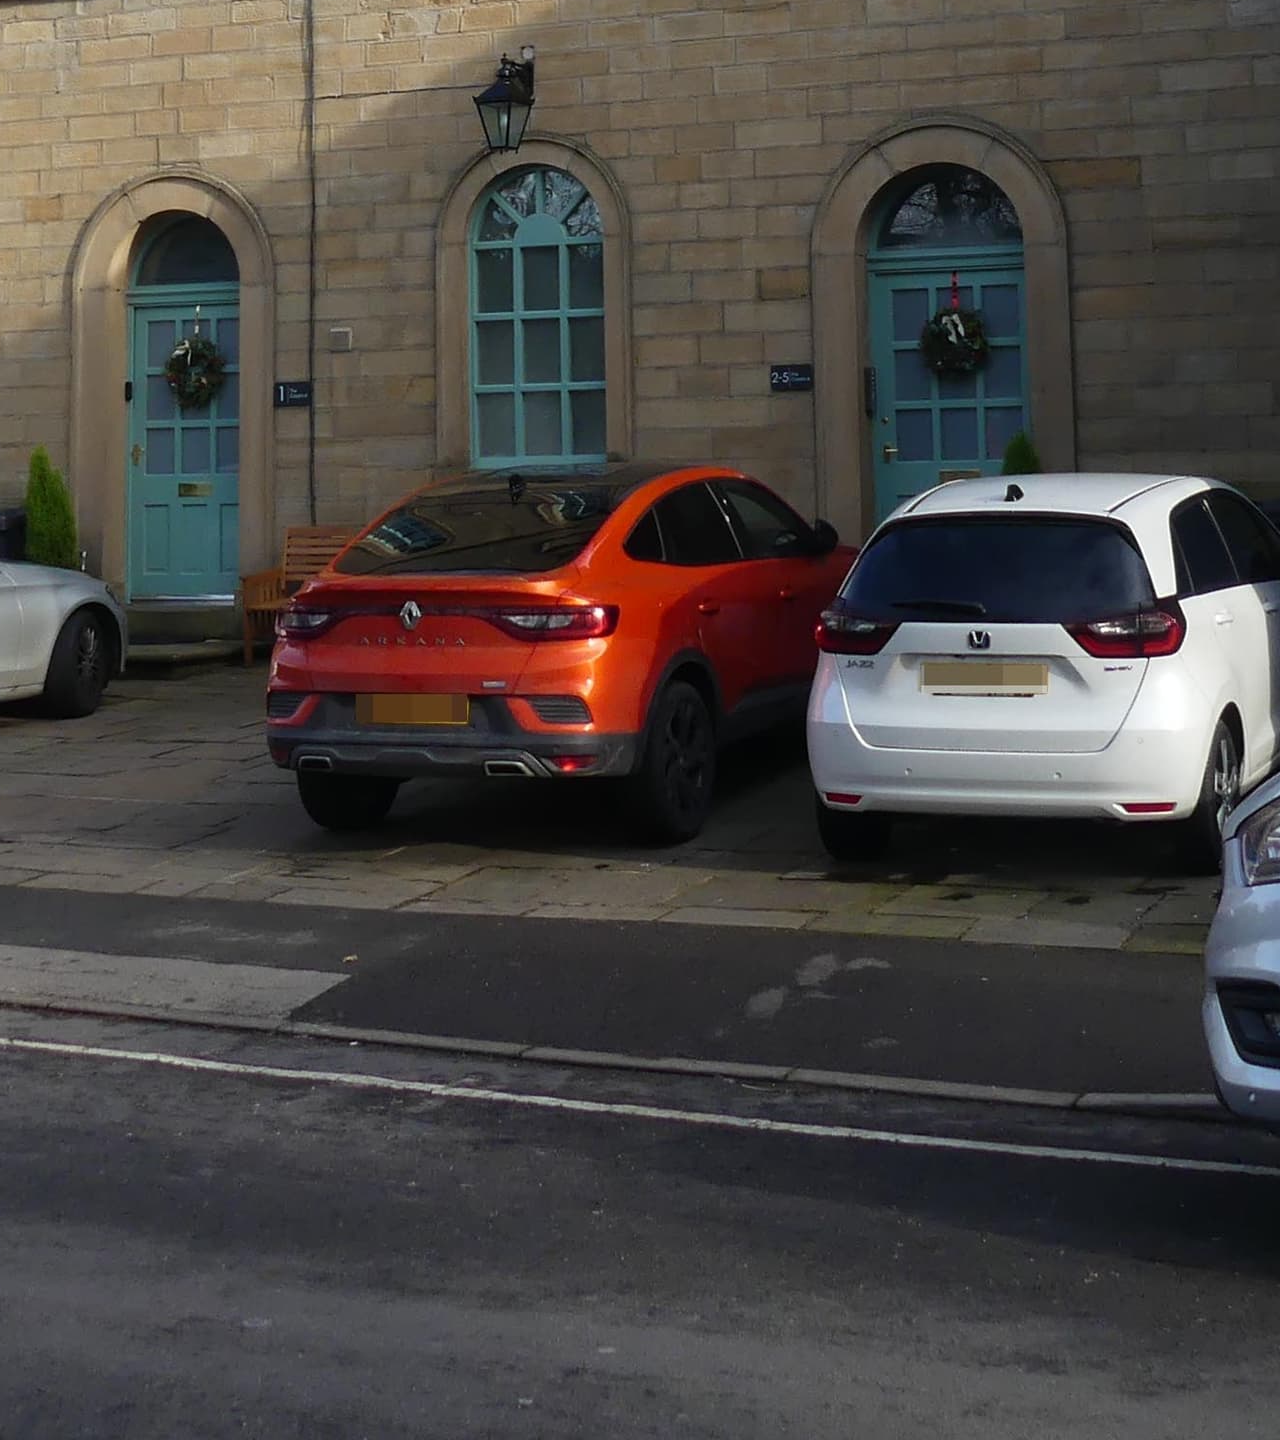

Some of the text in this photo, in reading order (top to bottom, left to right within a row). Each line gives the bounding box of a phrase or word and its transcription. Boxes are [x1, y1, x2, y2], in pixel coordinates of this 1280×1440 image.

[771, 371, 790, 384] 2-5
[278, 385, 285, 402] 1
[360, 636, 465, 646] ARKANA
[845, 659, 875, 669] JAZZ
